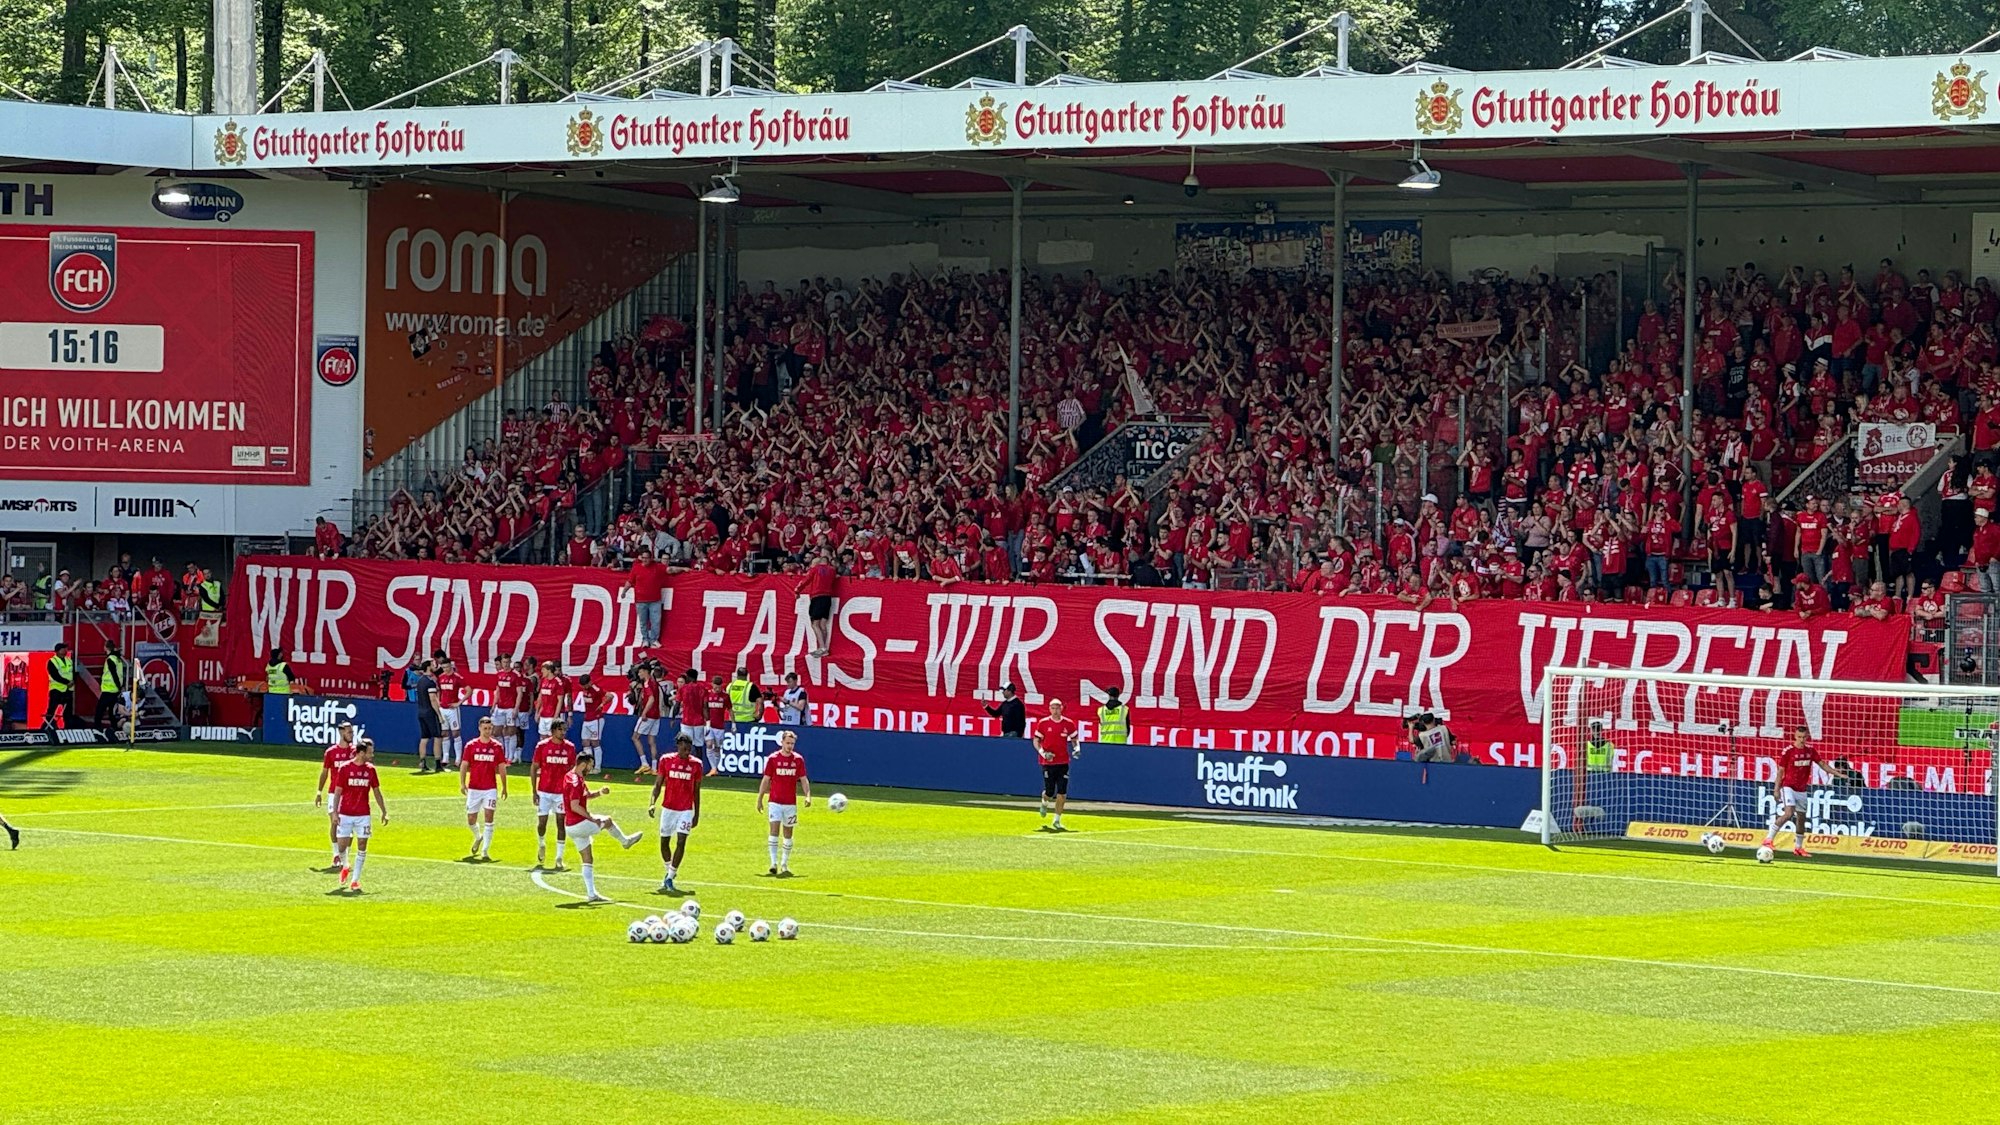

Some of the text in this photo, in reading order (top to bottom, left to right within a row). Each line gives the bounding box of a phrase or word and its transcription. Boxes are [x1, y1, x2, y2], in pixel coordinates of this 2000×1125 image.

[1471, 78, 1781, 134] Stuttgarter Hofbräu
[1014, 94, 1286, 144] Stuttgarter Hofbräu
[609, 106, 851, 155] Stuttgarter Hofbräu
[252, 119, 466, 165] Stuttgarter Hofbräu
[385, 226, 548, 297] roma
[63, 268, 104, 293] FCH
[48, 328, 119, 363] 15:16
[57, 398, 246, 432] WILLKOMMEN
[4, 435, 185, 454] DER VOITH-ARENA
[114, 497, 175, 518] PUMA
[246, 565, 356, 666] WIR
[376, 576, 540, 674] SIND
[1080, 598, 1278, 712] SIND
[1303, 606, 1472, 721] DER
[1518, 612, 1848, 741] VEREIN
[288, 698, 340, 724] hauff
[57, 729, 96, 744] PUMA
[190, 727, 237, 741] PUMA
[474, 754, 495, 762] REWE
[546, 756, 569, 764] REWE
[1197, 752, 1266, 784] hauff
[669, 771, 692, 780] REWE
[776, 767, 797, 776] REWE
[348, 777, 369, 787] REWE
[1204, 780, 1298, 810] technik
[1657, 828, 1689, 838] LOTTO
[1721, 831, 1754, 842] LOTTO
[1806, 835, 1839, 845] LOTTO
[1873, 839, 1908, 850] LOTTO
[1963, 844, 1998, 854] LOTTO
